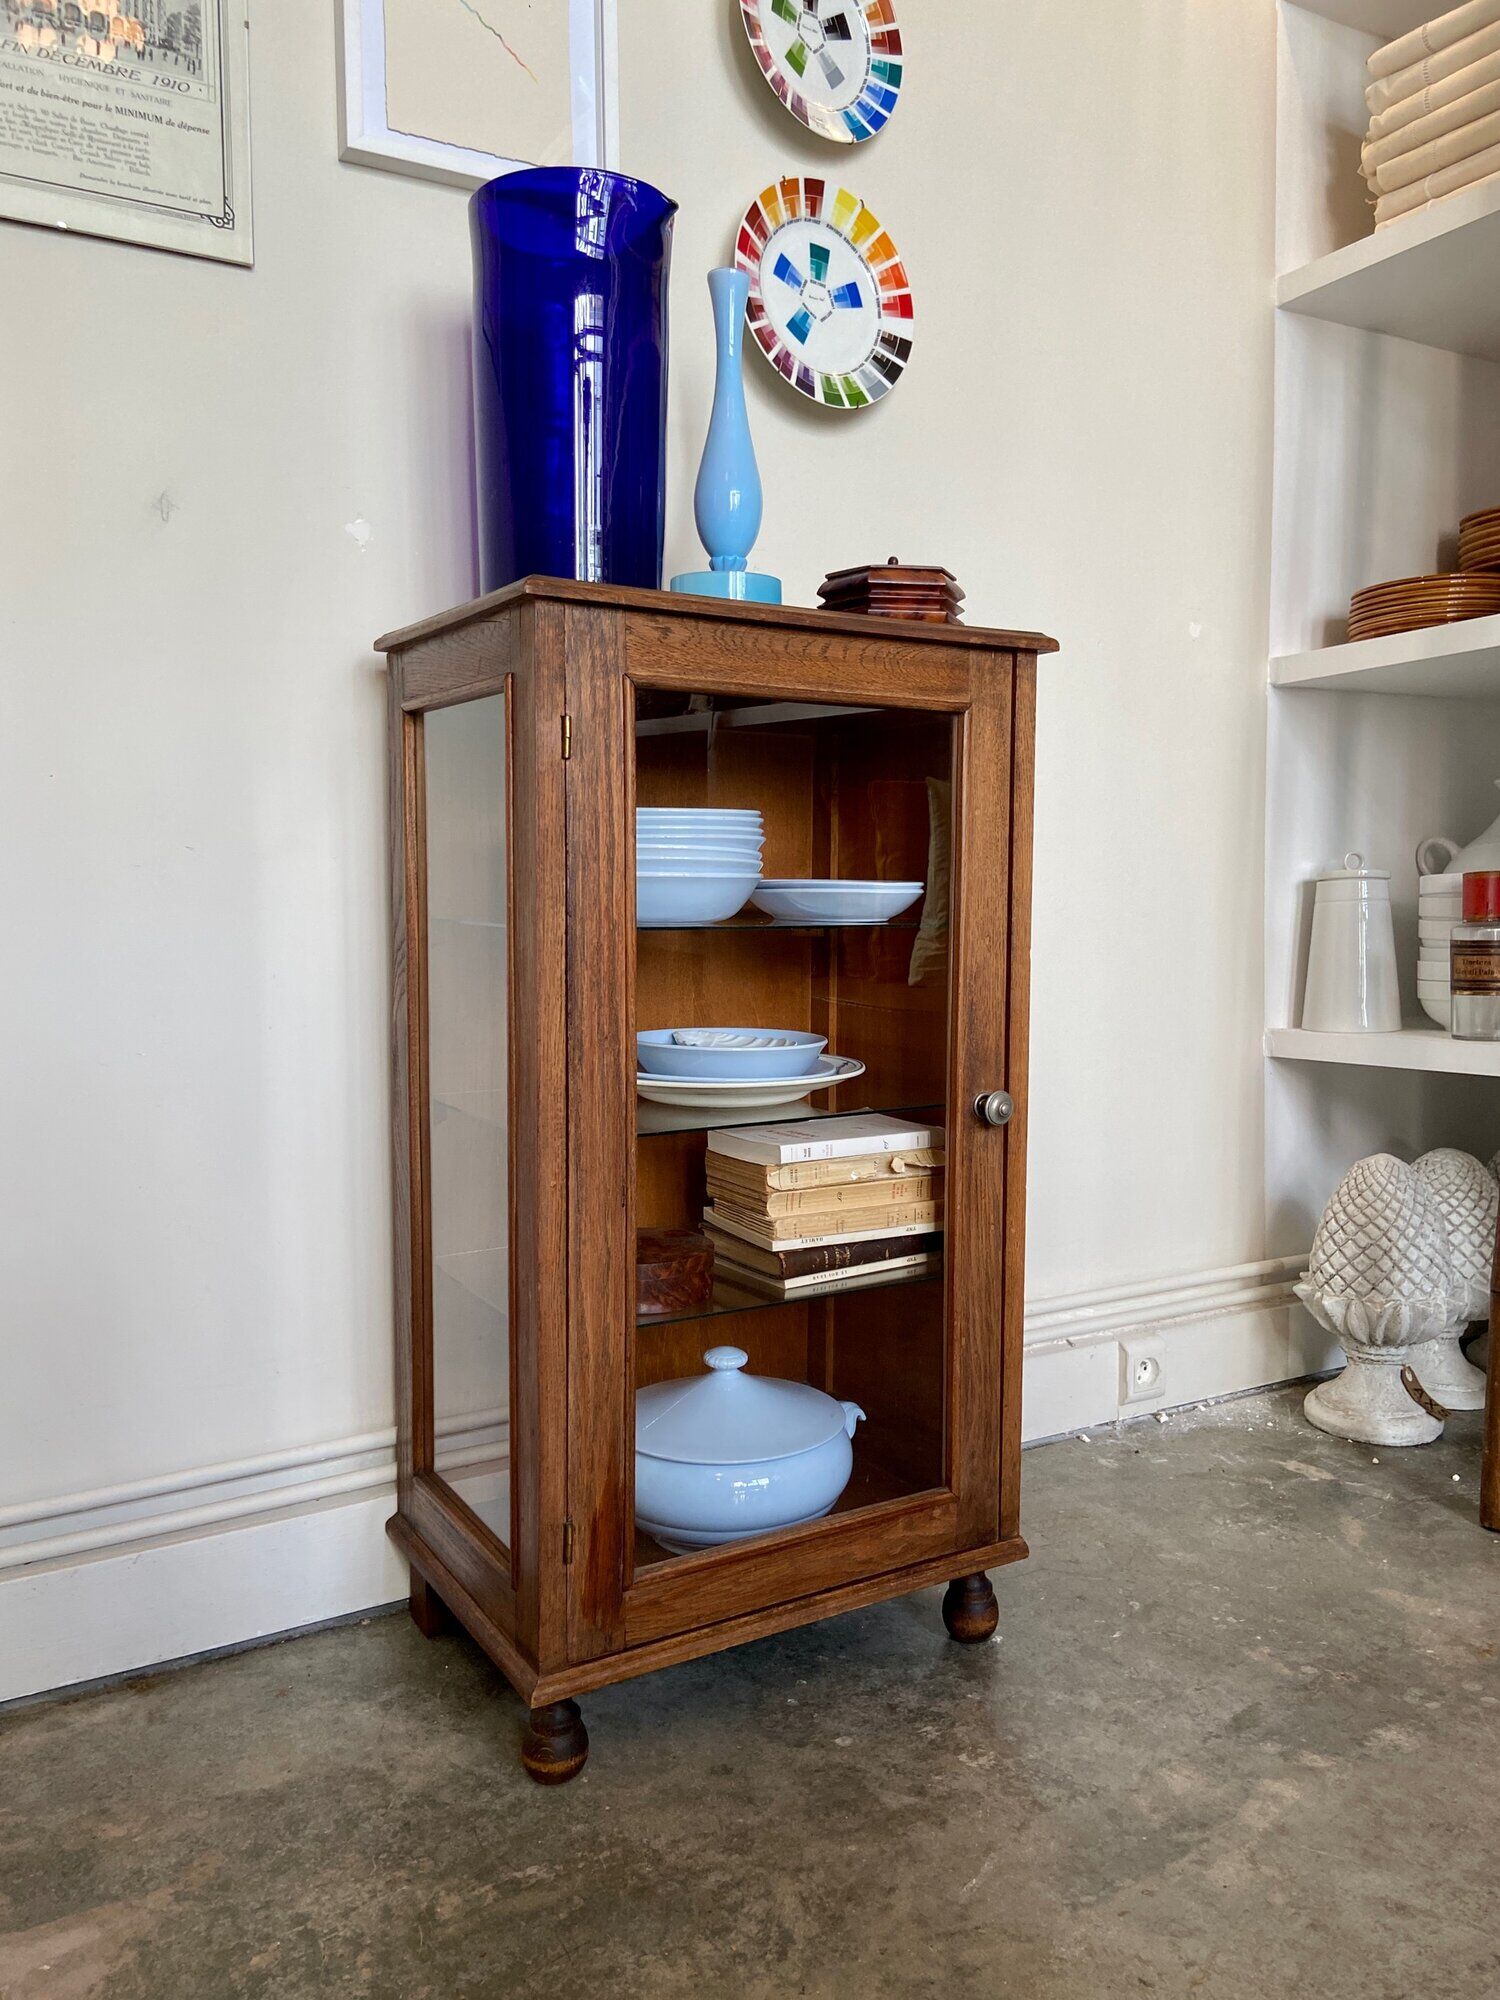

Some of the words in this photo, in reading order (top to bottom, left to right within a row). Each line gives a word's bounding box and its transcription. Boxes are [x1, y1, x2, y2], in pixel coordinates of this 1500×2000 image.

[152, 75, 190, 93] 1910
[15, 85, 24, 93] et
[27, 86, 39, 96] du
[82, 101, 103, 110] pour
[104, 103, 113, 112] le
[115, 106, 163, 124] MINIMUM
[165, 118, 176, 127] de
[177, 120, 211, 135] dépense
